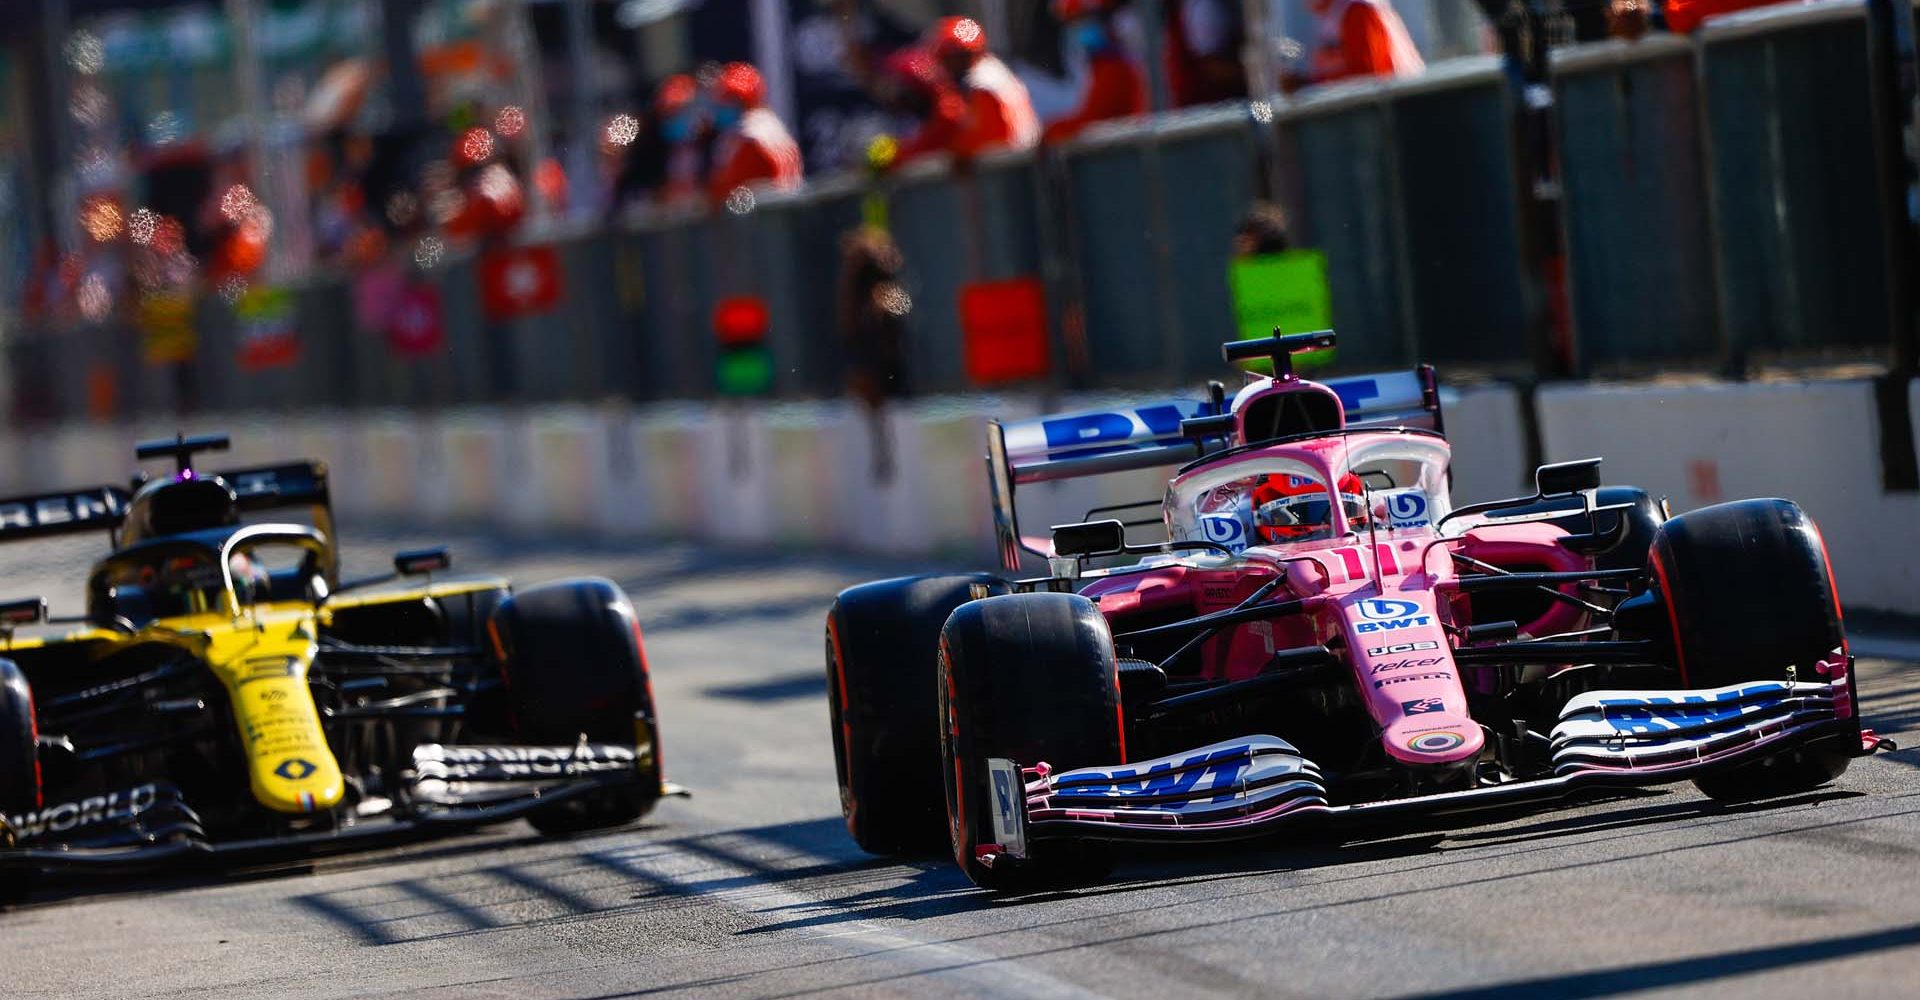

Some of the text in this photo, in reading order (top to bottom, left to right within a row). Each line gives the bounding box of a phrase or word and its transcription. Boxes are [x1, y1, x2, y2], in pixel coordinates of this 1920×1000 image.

[1331, 543, 1399, 581] 11
[1356, 616, 1431, 634] BWT
[1368, 641, 1439, 657] JCB
[1370, 656, 1446, 676] telcel
[1599, 683, 1787, 745] BWT
[1054, 744, 1251, 809] BWT
[11, 783, 156, 840] WORLD
